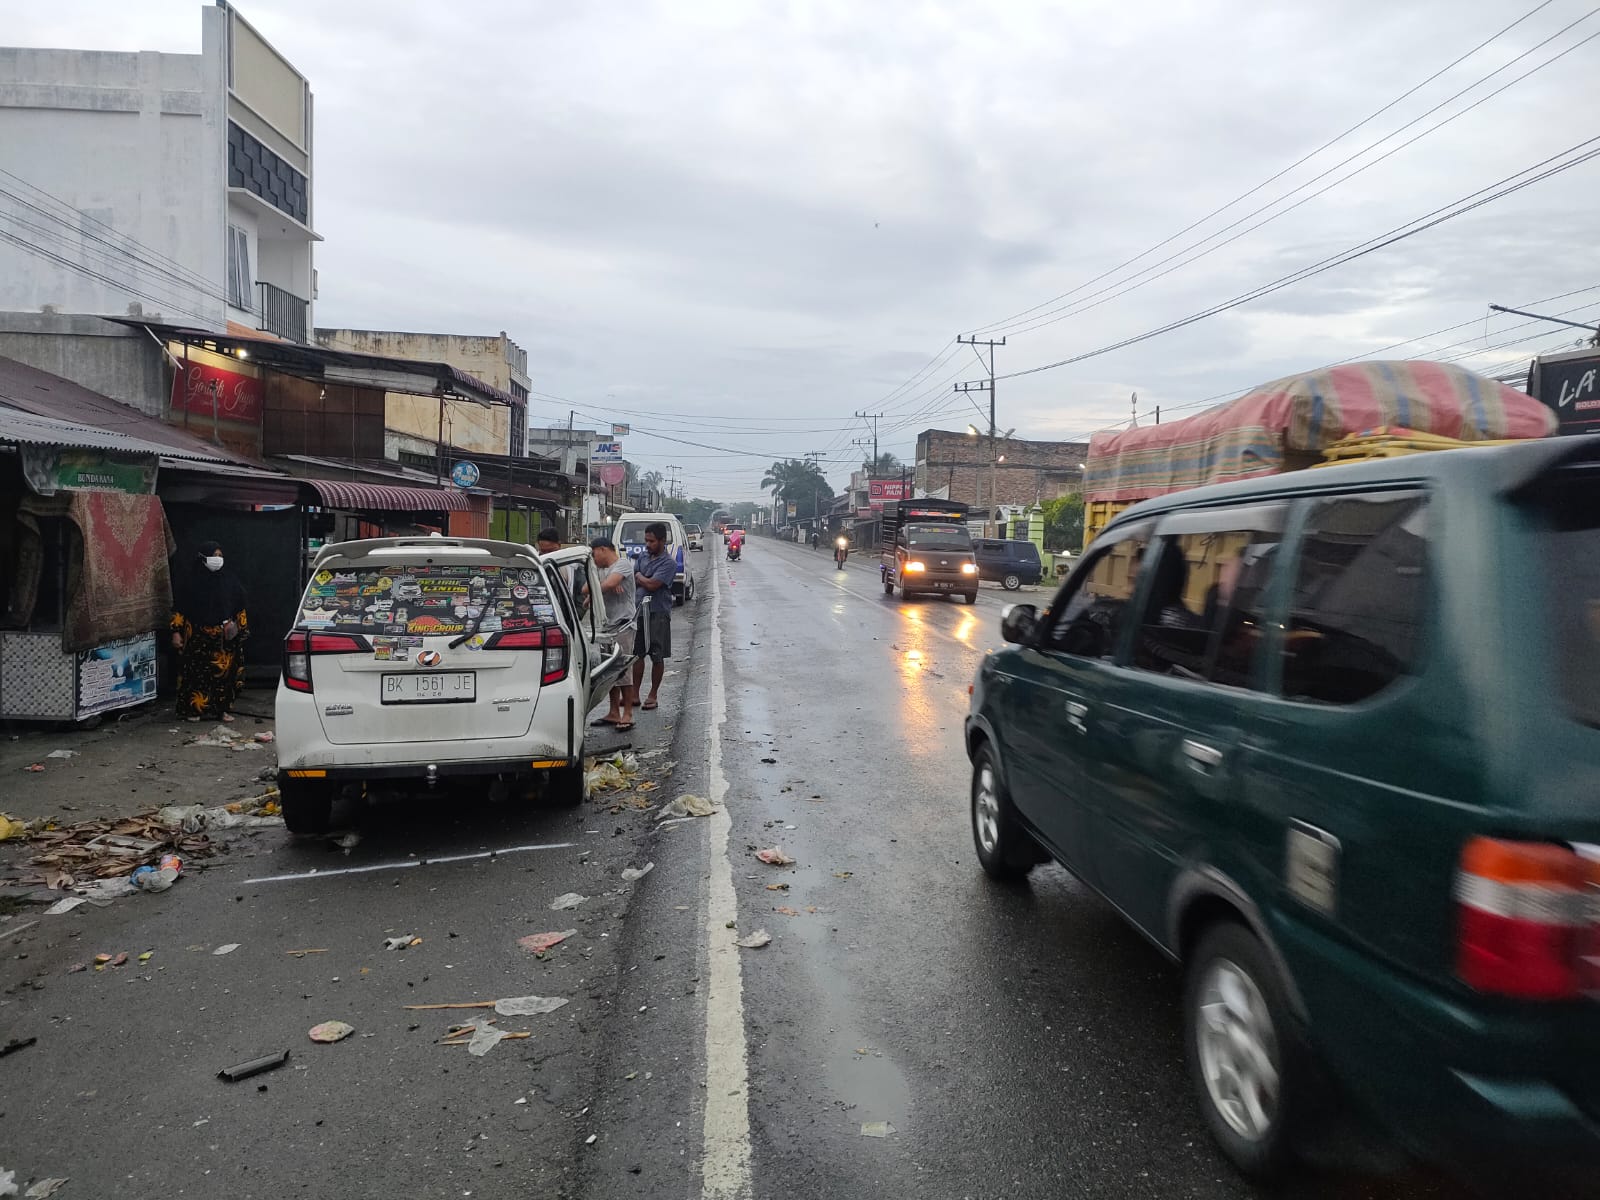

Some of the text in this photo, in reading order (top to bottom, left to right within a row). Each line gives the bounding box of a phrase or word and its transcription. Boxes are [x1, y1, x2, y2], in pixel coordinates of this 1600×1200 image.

[595, 444, 620, 453] JNE
[433, 623, 464, 632] GROUP
[387, 674, 472, 692] BK 1561 JE
